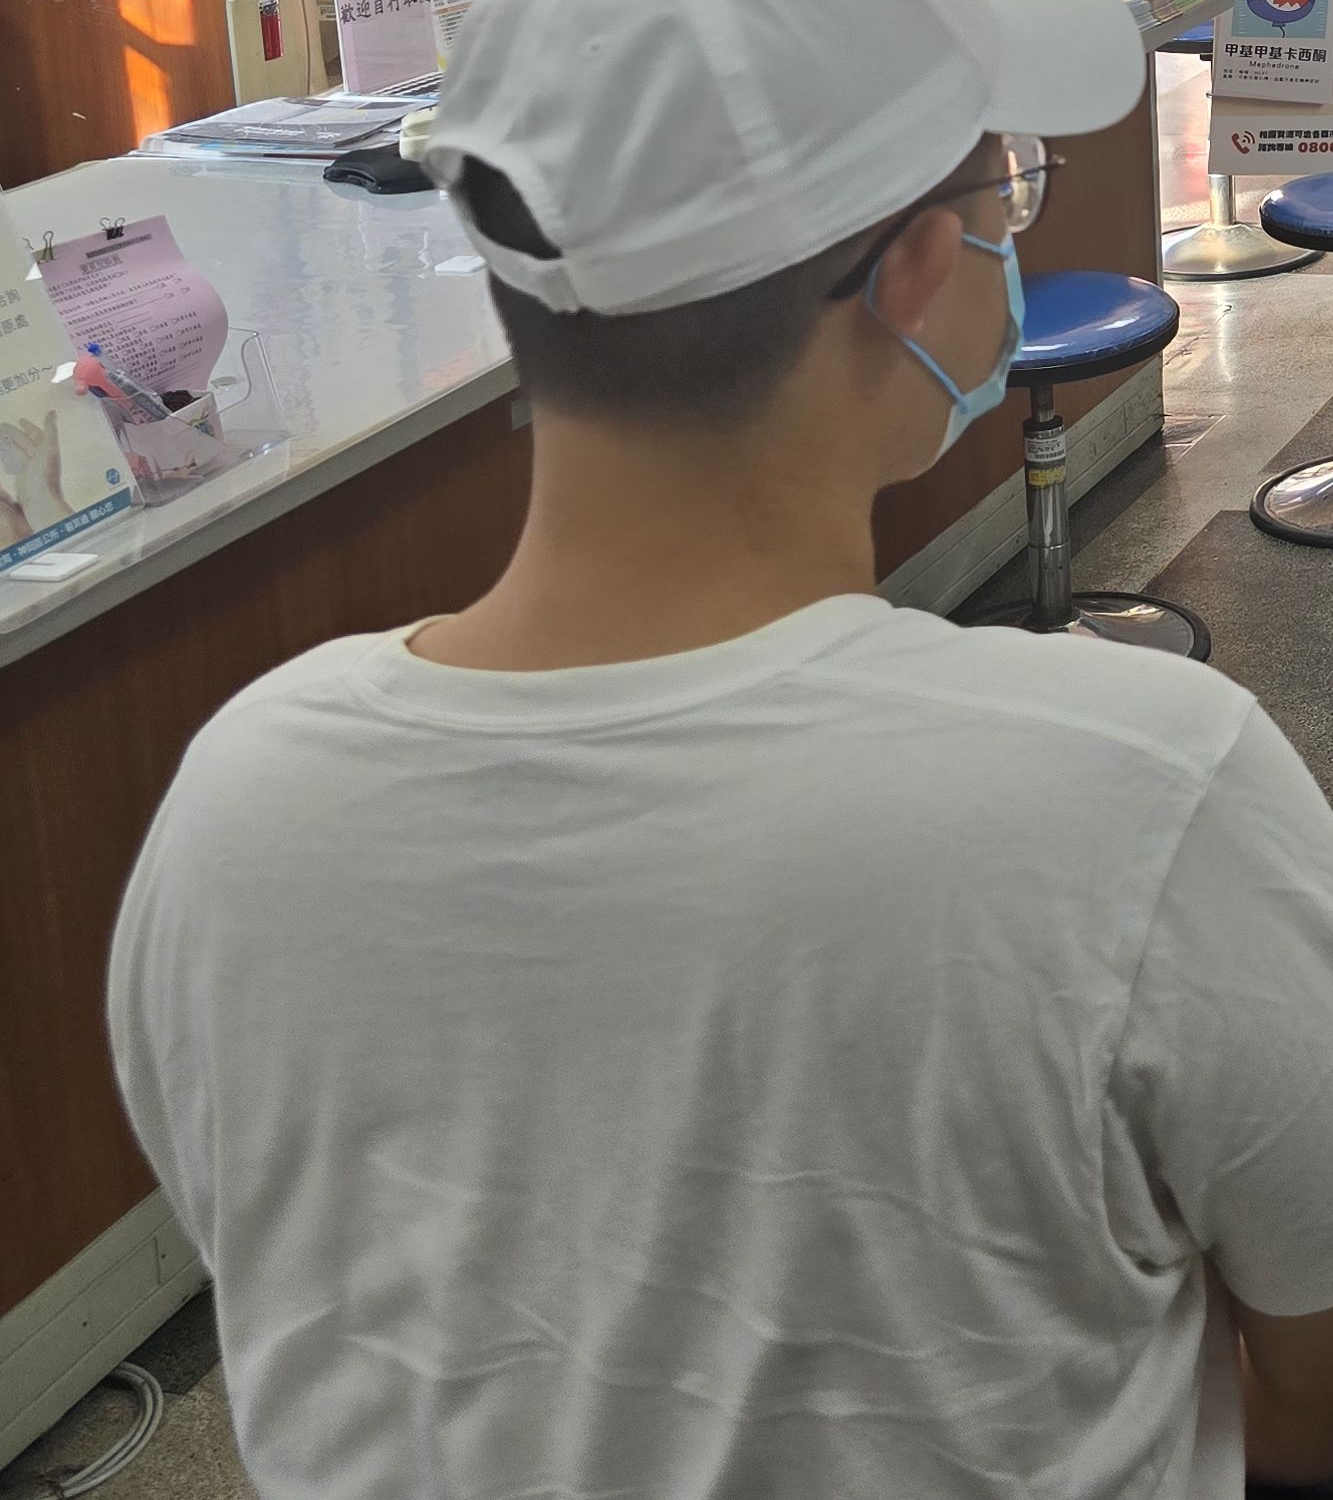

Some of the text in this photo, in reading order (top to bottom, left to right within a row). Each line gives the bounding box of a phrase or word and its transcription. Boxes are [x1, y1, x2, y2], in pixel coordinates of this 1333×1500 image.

[1225, 43, 1327, 62] 甲基甲基卡西酮
[1249, 60, 1300, 69] Mephedrone
